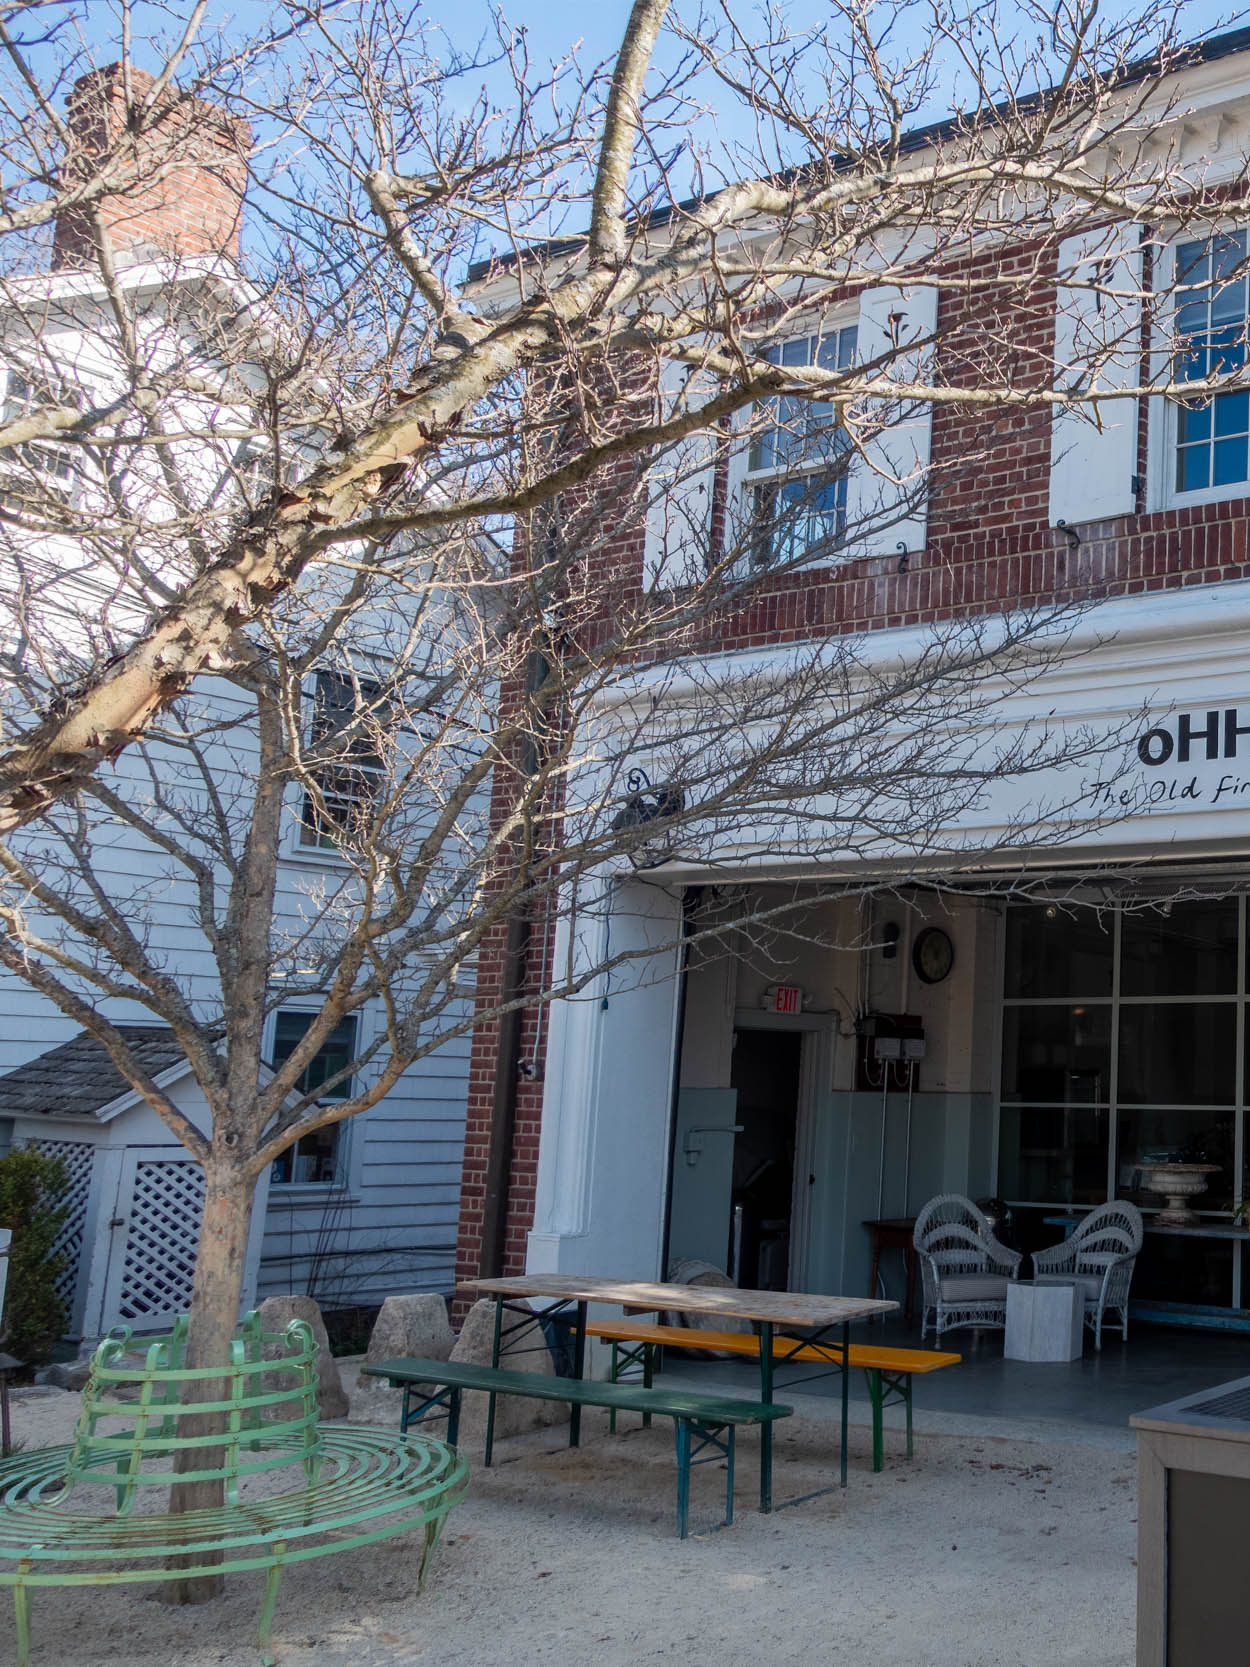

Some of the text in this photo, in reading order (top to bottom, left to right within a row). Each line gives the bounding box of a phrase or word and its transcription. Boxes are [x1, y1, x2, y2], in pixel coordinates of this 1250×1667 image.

[1090, 781, 1133, 808] The
[1149, 777, 1202, 802] Old
[776, 988, 799, 1012] EXIT
